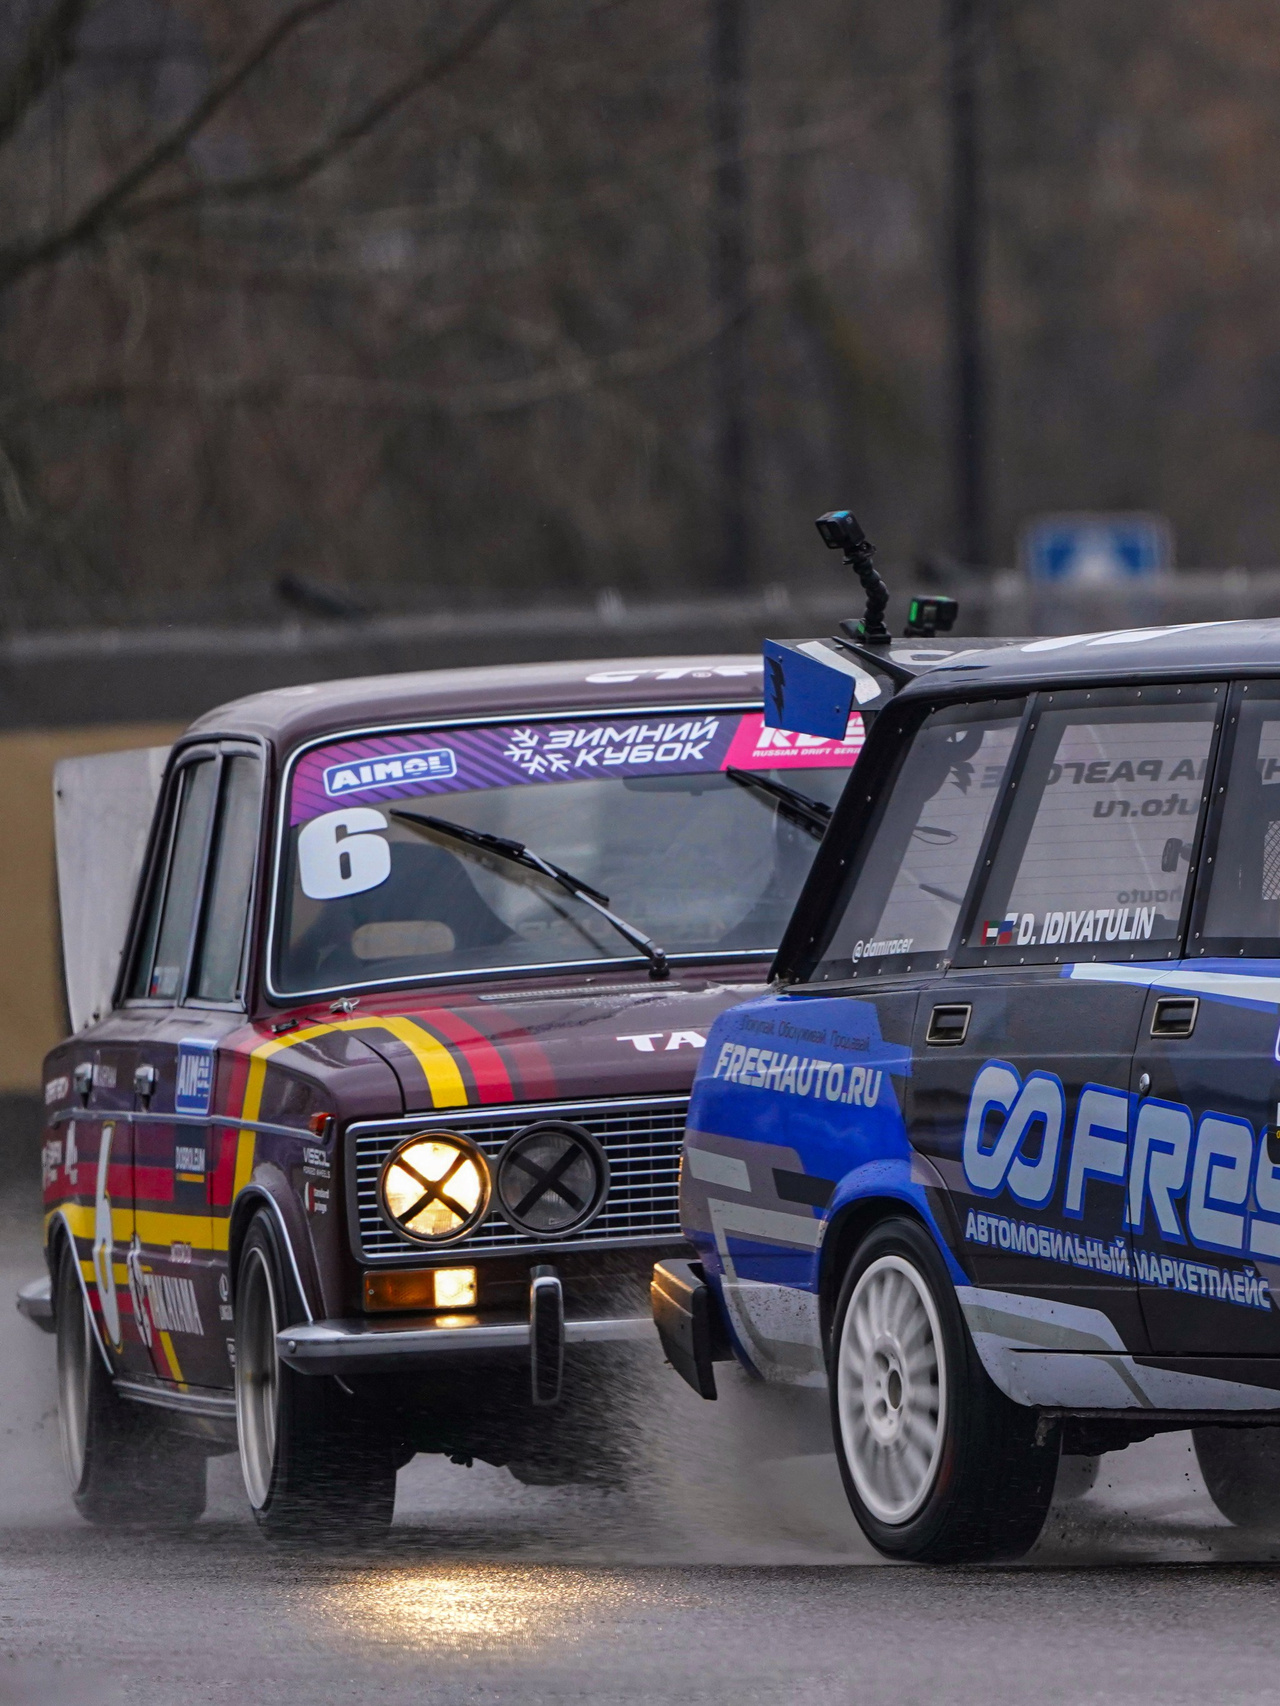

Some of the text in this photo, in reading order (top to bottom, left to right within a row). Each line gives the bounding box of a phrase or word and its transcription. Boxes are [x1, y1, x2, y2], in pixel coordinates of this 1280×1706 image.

[542, 716, 719, 750] ЗИМНИЙ
[573, 741, 712, 767] КУБОК
[752, 749, 797, 757] RUSSIAN
[801, 748, 831, 756] DRIFT
[330, 754, 452, 790] AIMOL
[298, 808, 391, 900] 6
[1017, 906, 1157, 946] D. IDIYATULIN
[852, 938, 914, 963] @damiracer
[712, 1042, 883, 1109] FRESHAUTO.RU
[964, 1211, 1272, 1310] АВТОМОБИЛЬНЫЙ МАРКЕТПЛЕЙС
